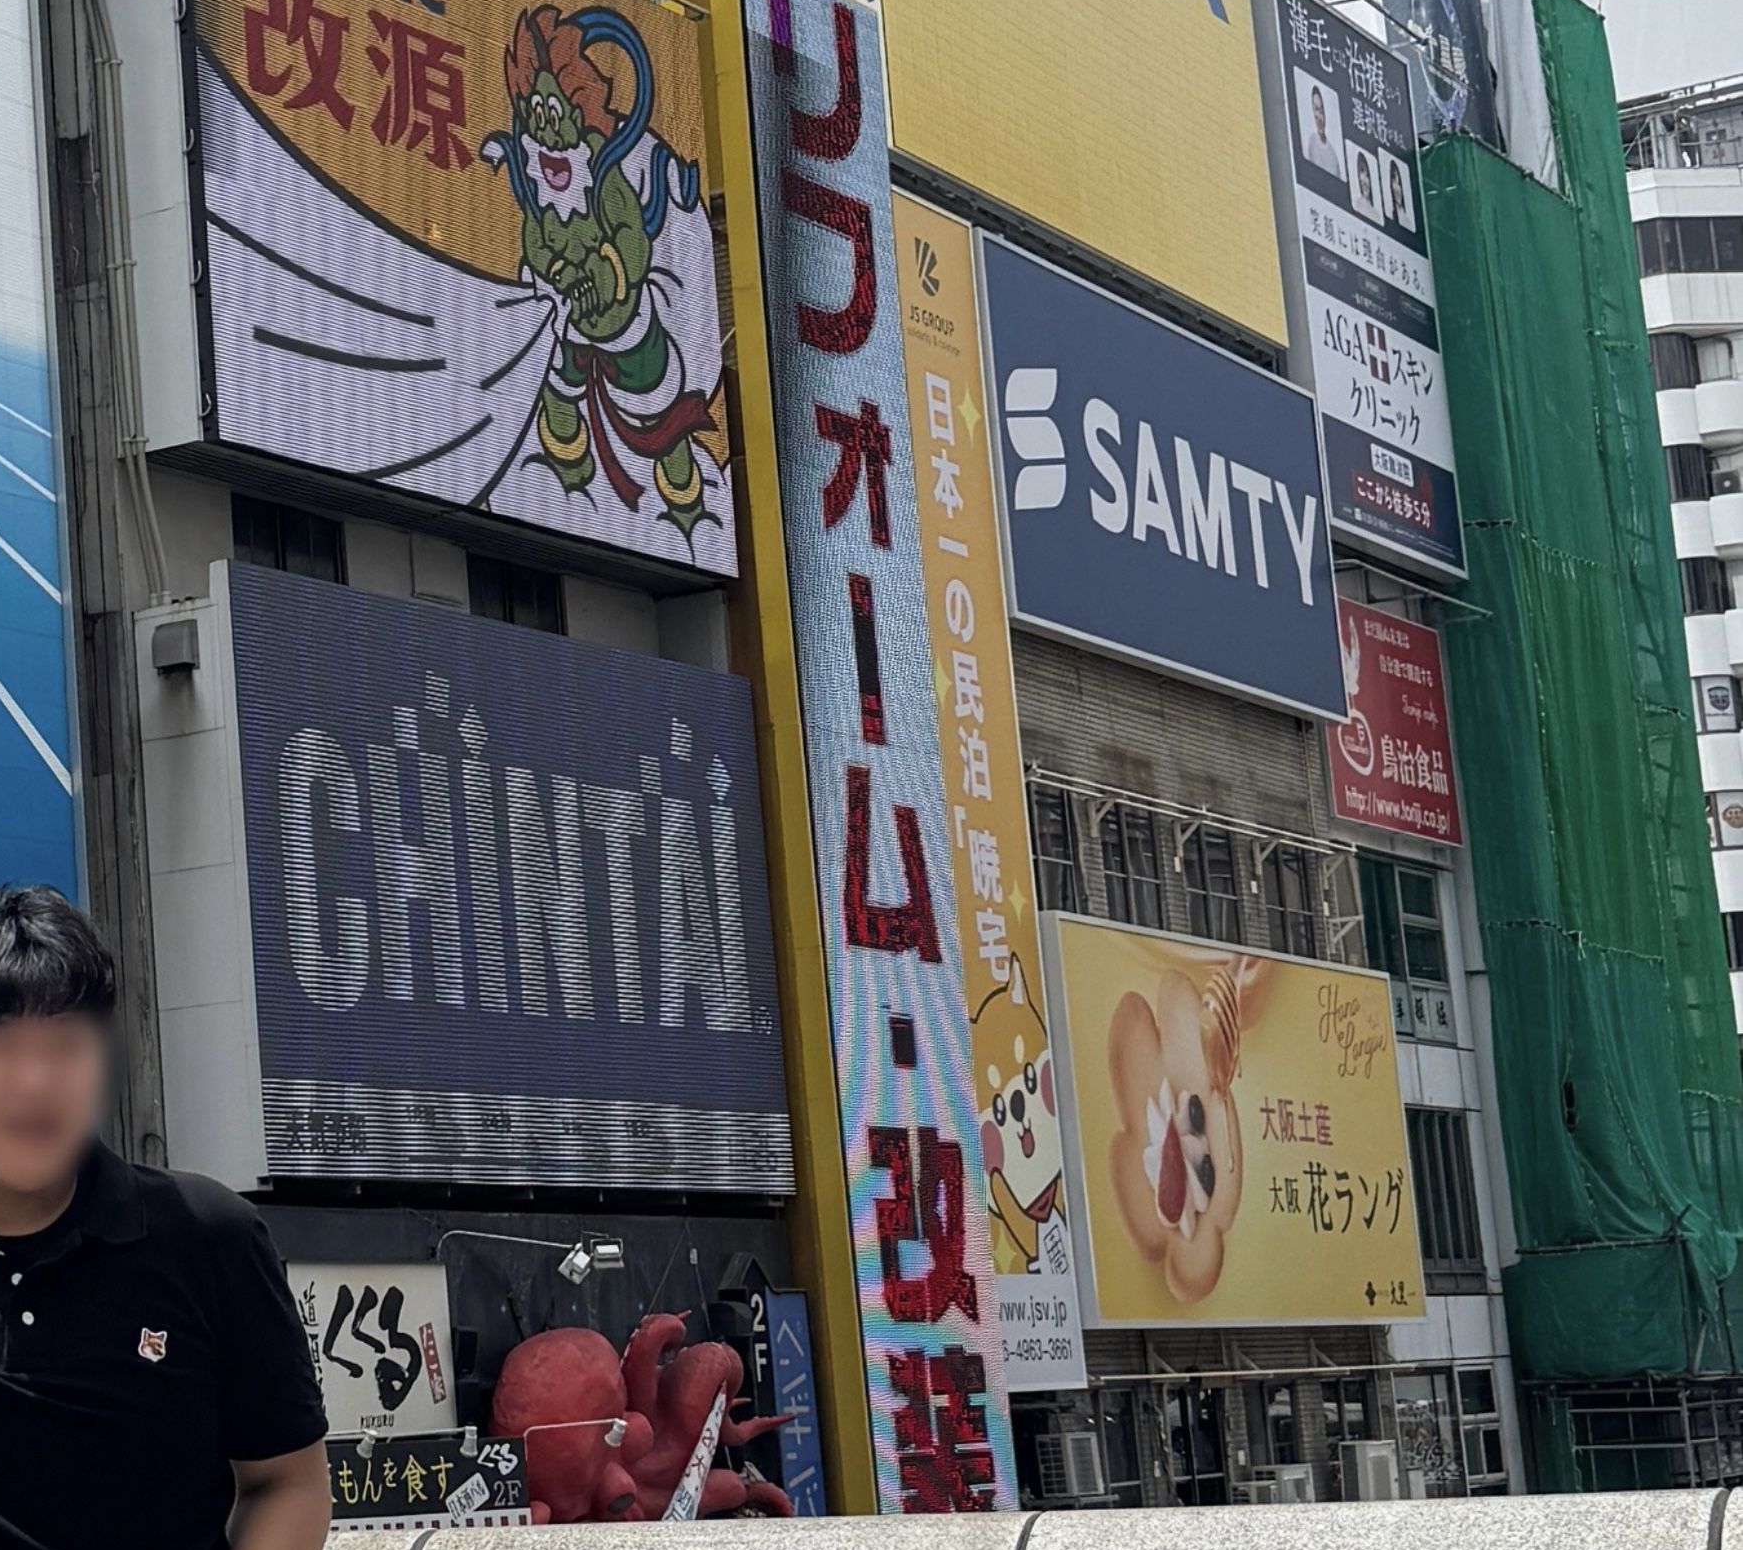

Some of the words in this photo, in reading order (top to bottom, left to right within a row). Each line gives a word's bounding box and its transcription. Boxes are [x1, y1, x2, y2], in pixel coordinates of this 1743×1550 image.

[1324, 307, 1368, 367] AGA
[1391, 349, 1434, 397] スキン
[1350, 377, 1421, 447] クリニック
[1083, 397, 1317, 607] SAMTY
[1259, 1097, 1334, 1146] 大阪土産
[327, 1454, 454, 1504] もんを食す
[494, 1479, 522, 1507] 2F
